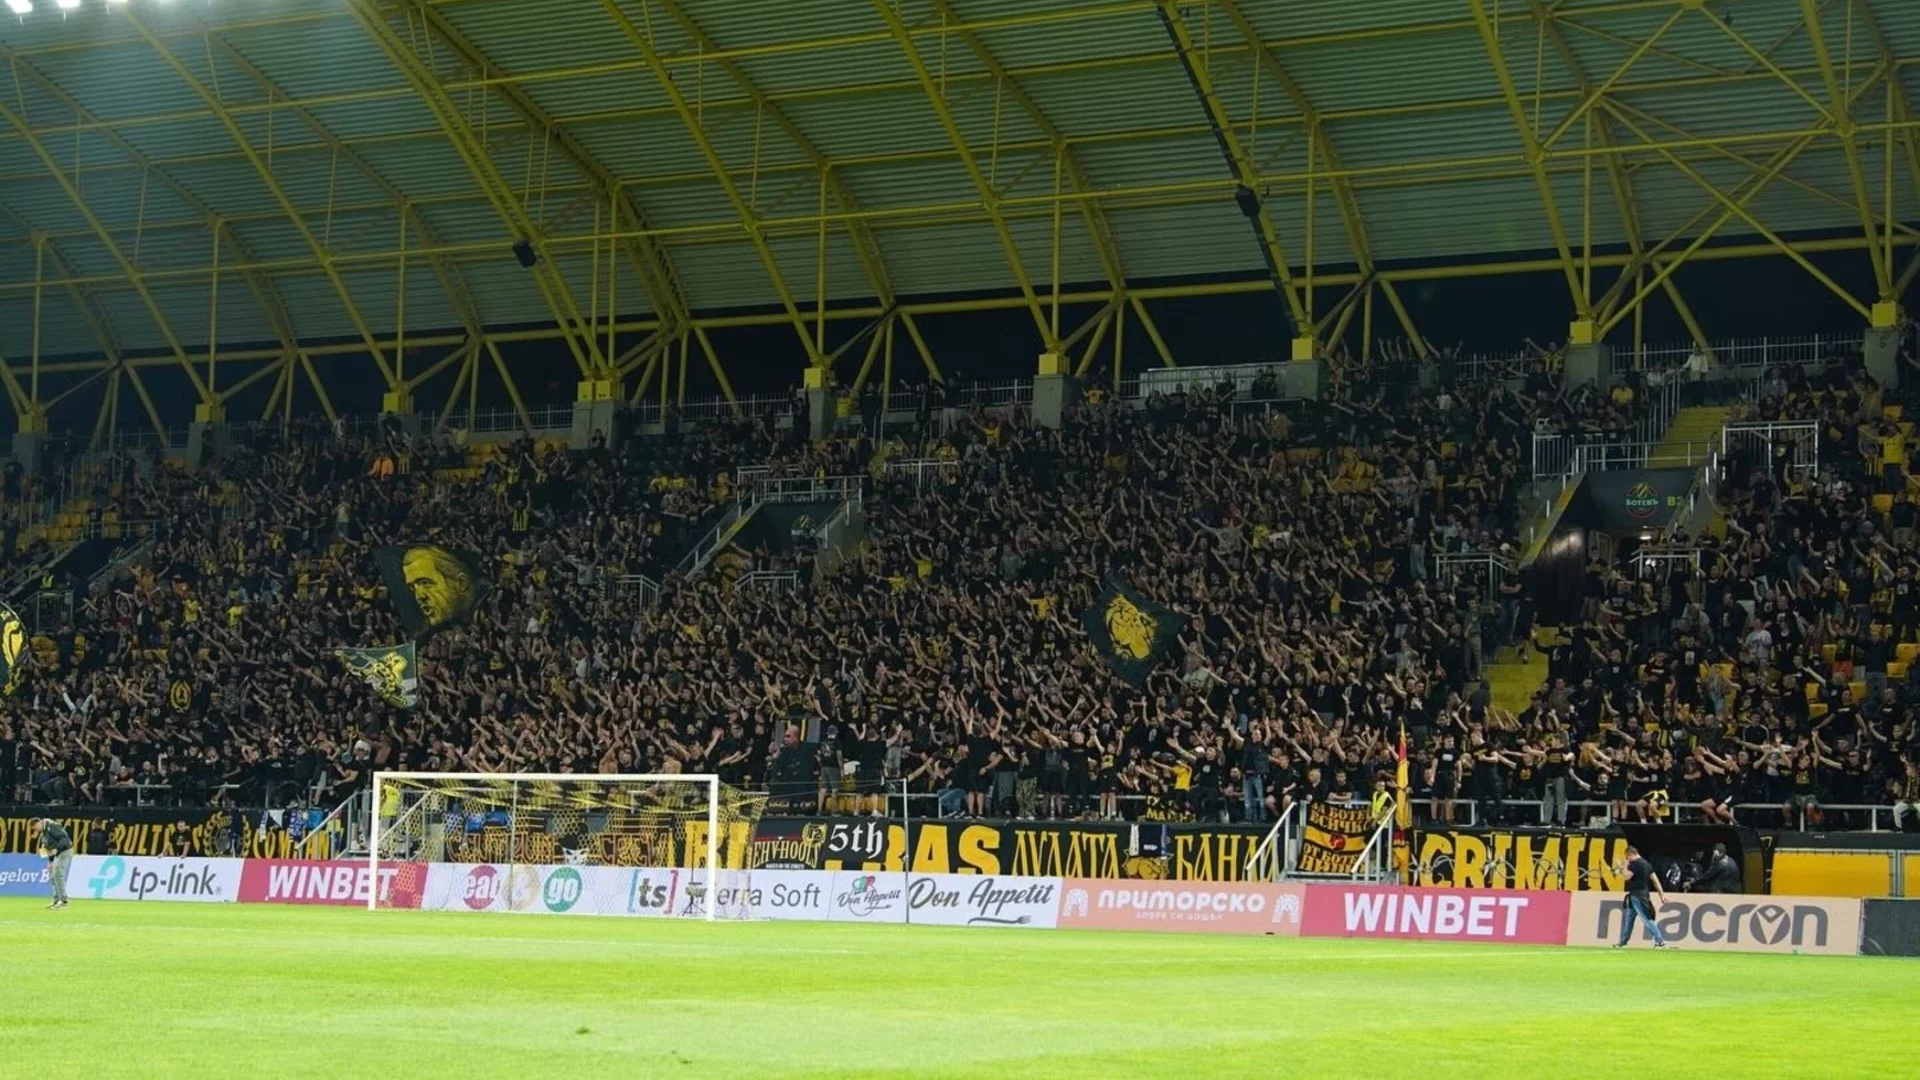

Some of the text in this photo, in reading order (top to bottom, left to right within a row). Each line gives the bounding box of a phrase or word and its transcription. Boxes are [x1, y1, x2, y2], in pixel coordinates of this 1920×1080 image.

[828, 822, 883, 859] 5th
[129, 863, 216, 900] tp-link
[268, 865, 398, 901] WINBET
[771, 883, 820, 908] Soft
[909, 877, 1054, 916] Don Appetit
[1344, 893, 1528, 937] WINBET
[1597, 900, 1828, 946] macron
